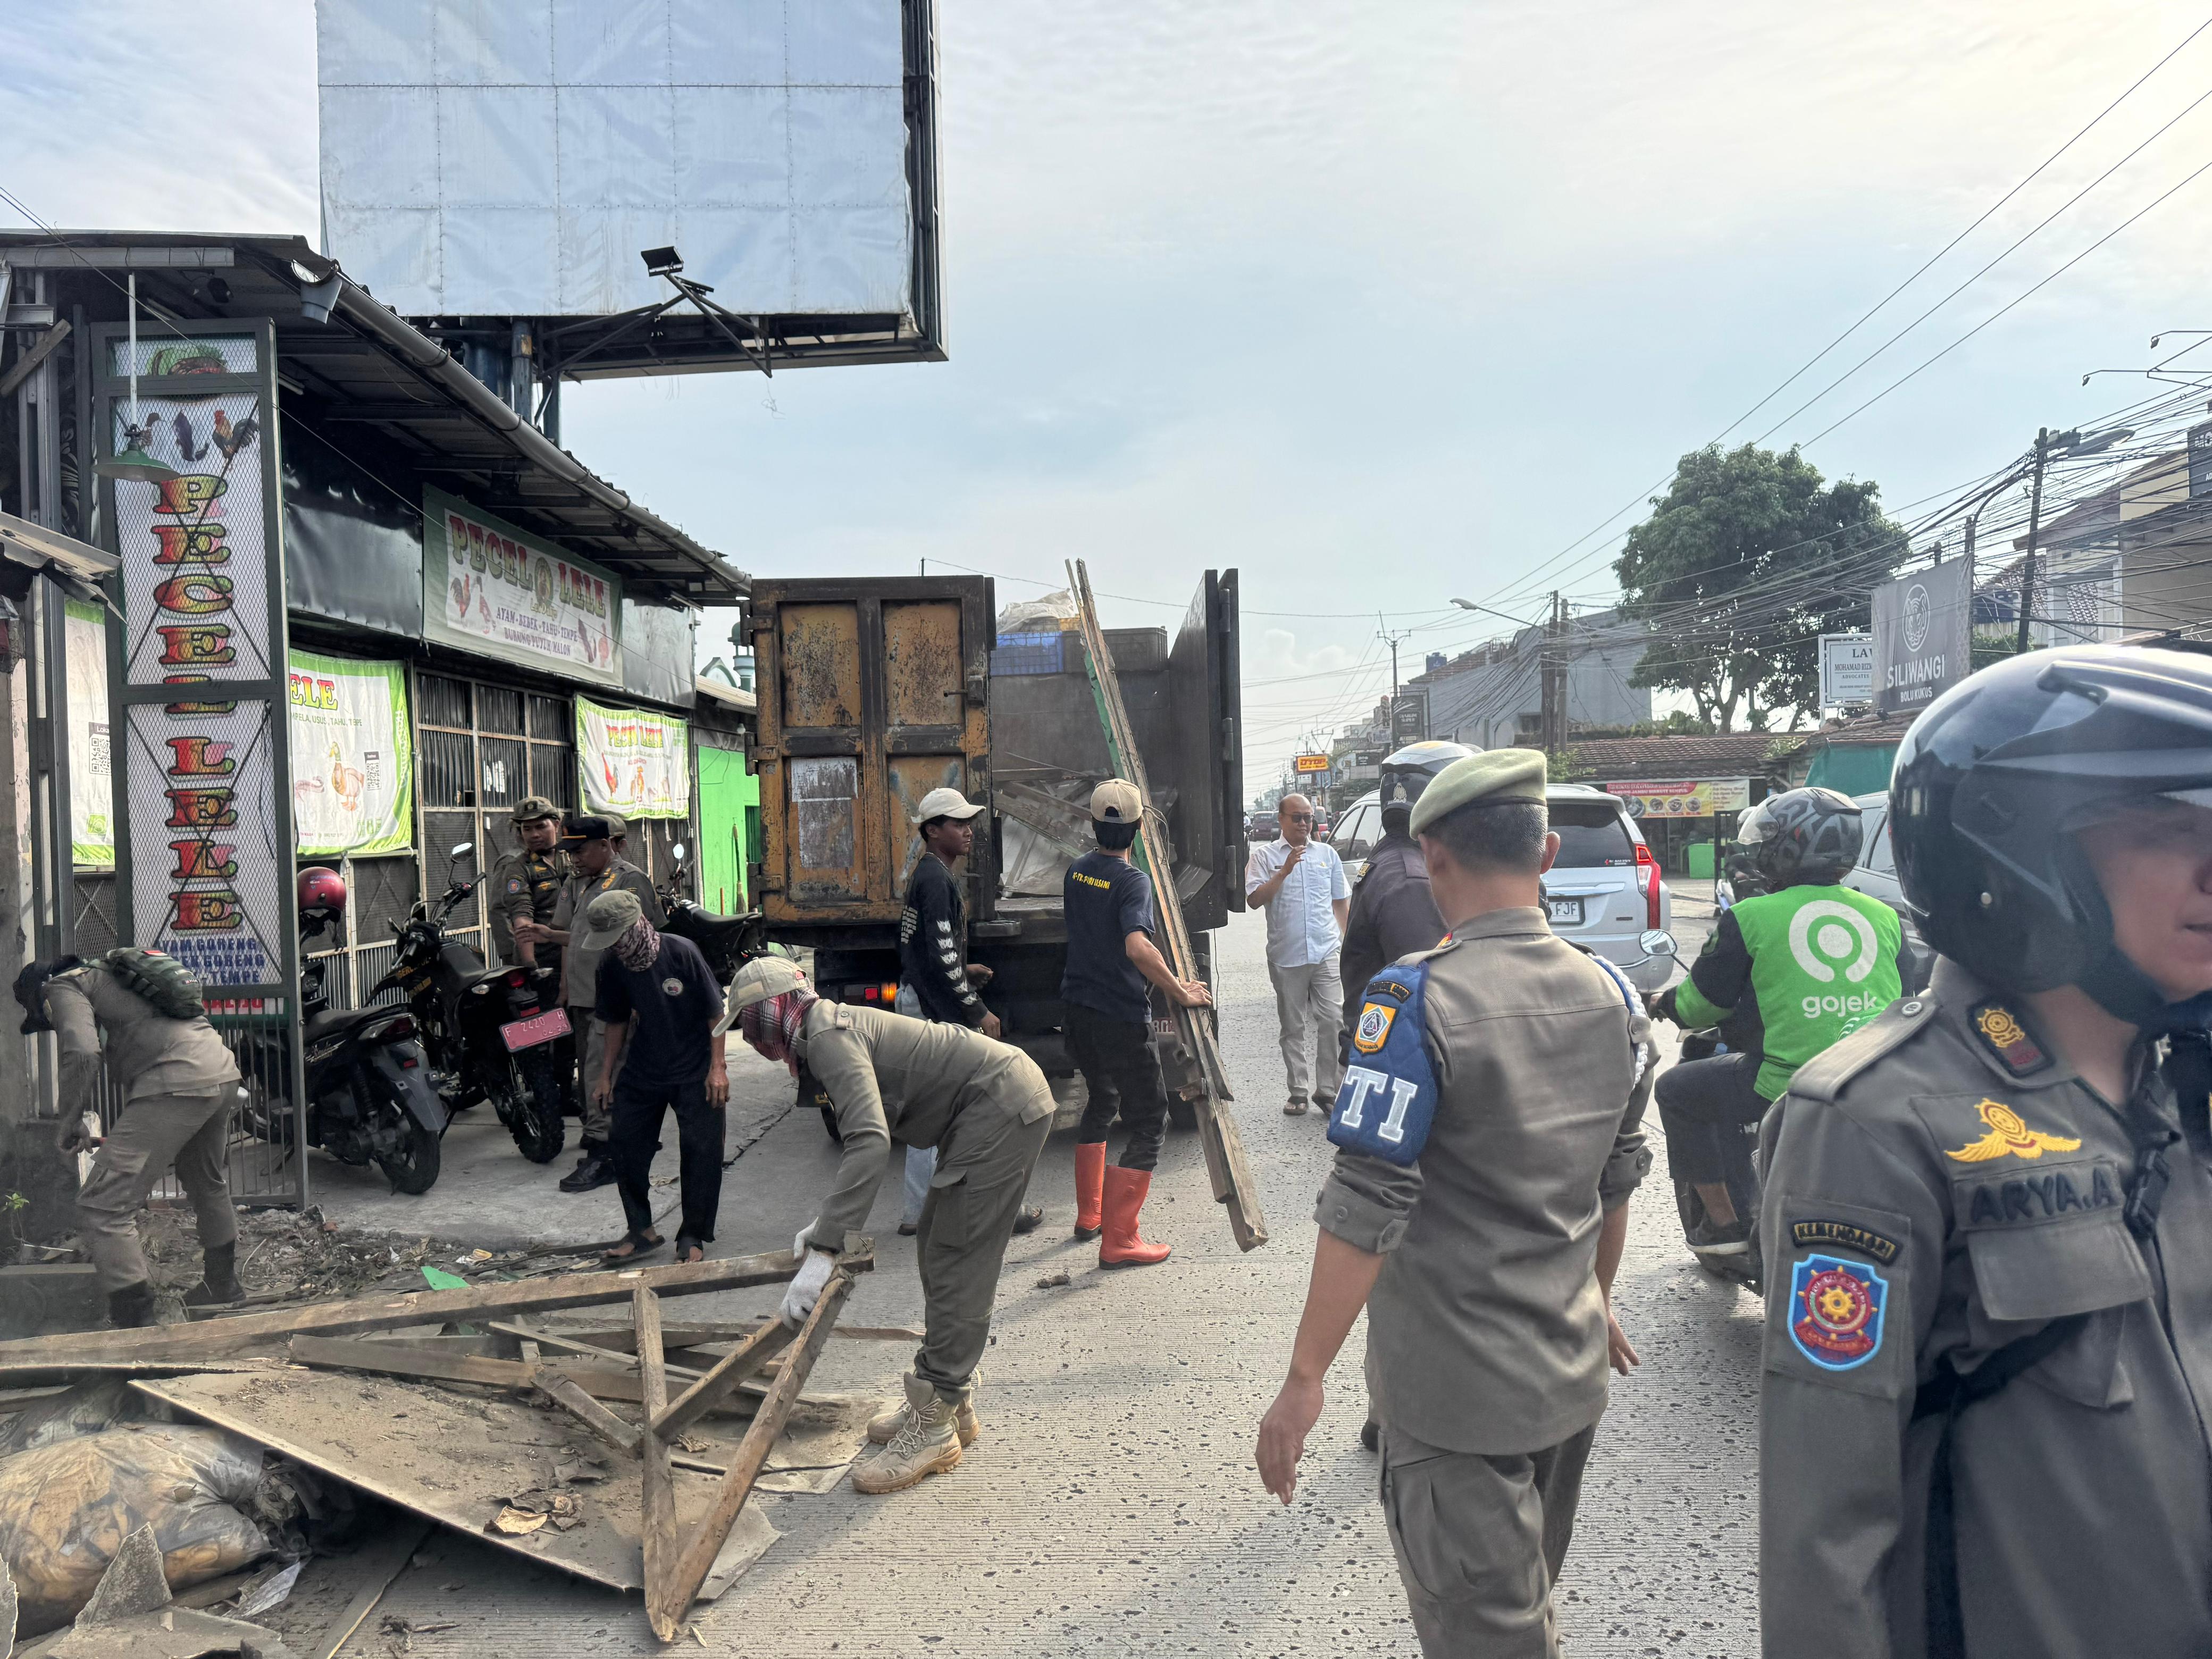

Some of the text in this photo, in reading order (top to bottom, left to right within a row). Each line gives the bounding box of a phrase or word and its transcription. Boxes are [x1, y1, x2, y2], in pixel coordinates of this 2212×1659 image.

[449, 515, 607, 619] PECEL LELE
[496, 607, 578, 642] AYAM BEBEK TAHU TEMPE
[504, 627, 531, 645] BURUNG
[1887, 654, 1945, 688] SILIWANGI
[1900, 686, 1933, 702] BOLU KUKUS
[163, 736, 242, 931] LELE
[1556, 903, 1577, 915] FJF
[196, 937, 256, 951] GORENG
[1802, 991, 1877, 1018] gojek
[505, 1010, 565, 1037] F 2420 H
[1795, 1223, 1894, 1258] KEMENDAGRI
